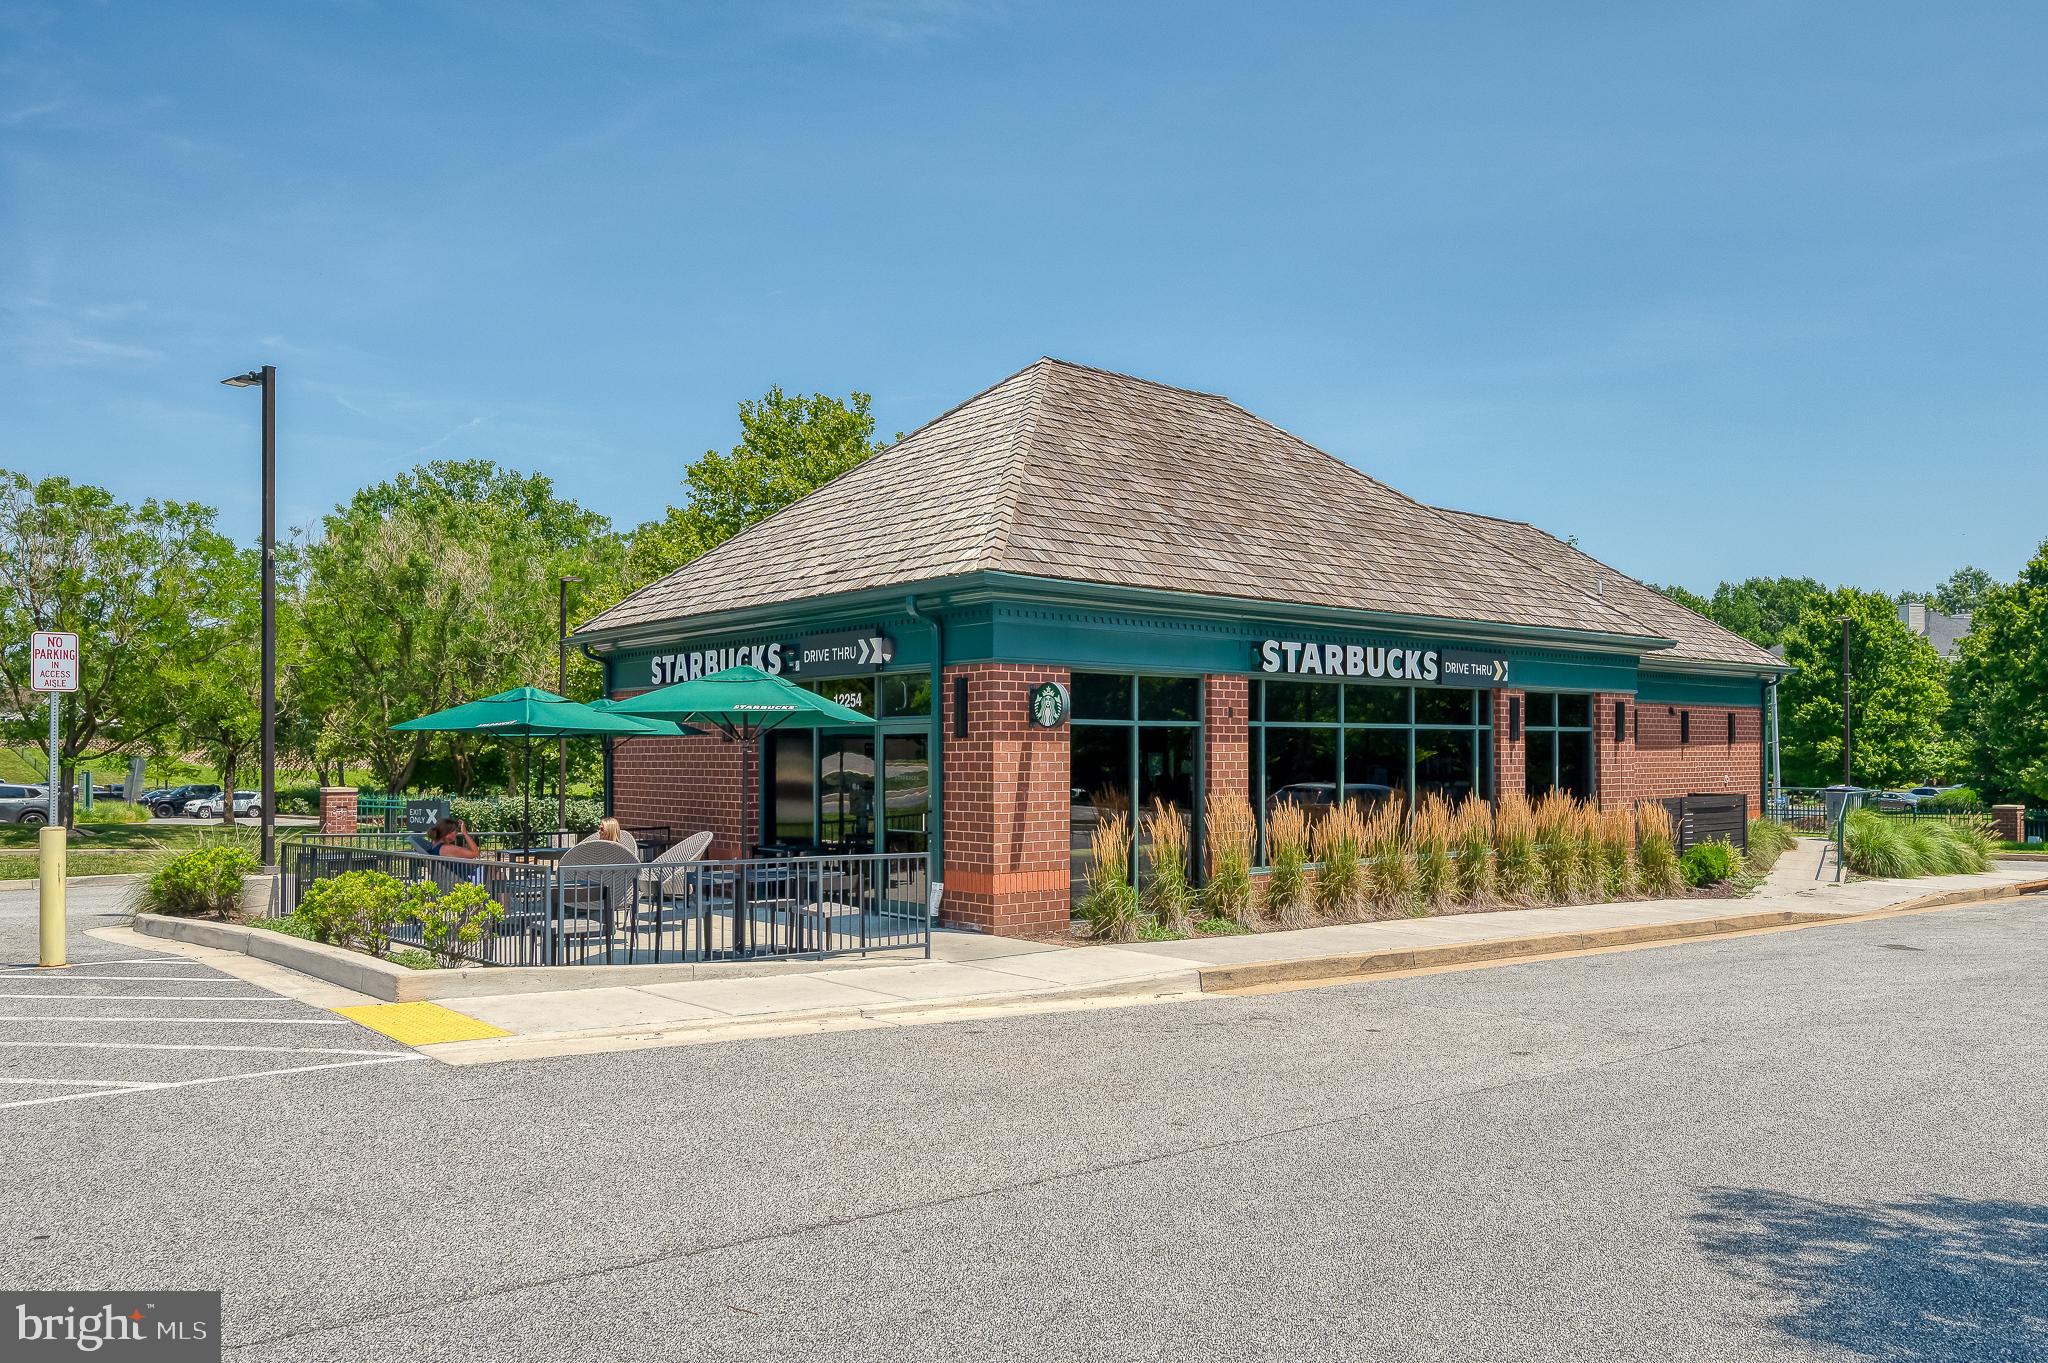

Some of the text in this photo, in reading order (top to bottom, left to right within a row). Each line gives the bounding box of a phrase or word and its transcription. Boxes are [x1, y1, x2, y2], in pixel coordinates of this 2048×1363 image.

[47, 637, 63, 648] NO
[35, 649, 76, 660] PARKING
[803, 646, 857, 663] DRIVE THRU
[1262, 639, 1438, 681] STARBUCKS
[51, 661, 60, 669] IN
[651, 643, 782, 685] STARBUCKS
[1445, 662, 1493, 676] DRIVE THRU
[40, 670, 71, 679] ACCESS
[44, 680, 67, 688] AISLE
[833, 692, 863, 708] 12254
[409, 816, 426, 824] ONLY
